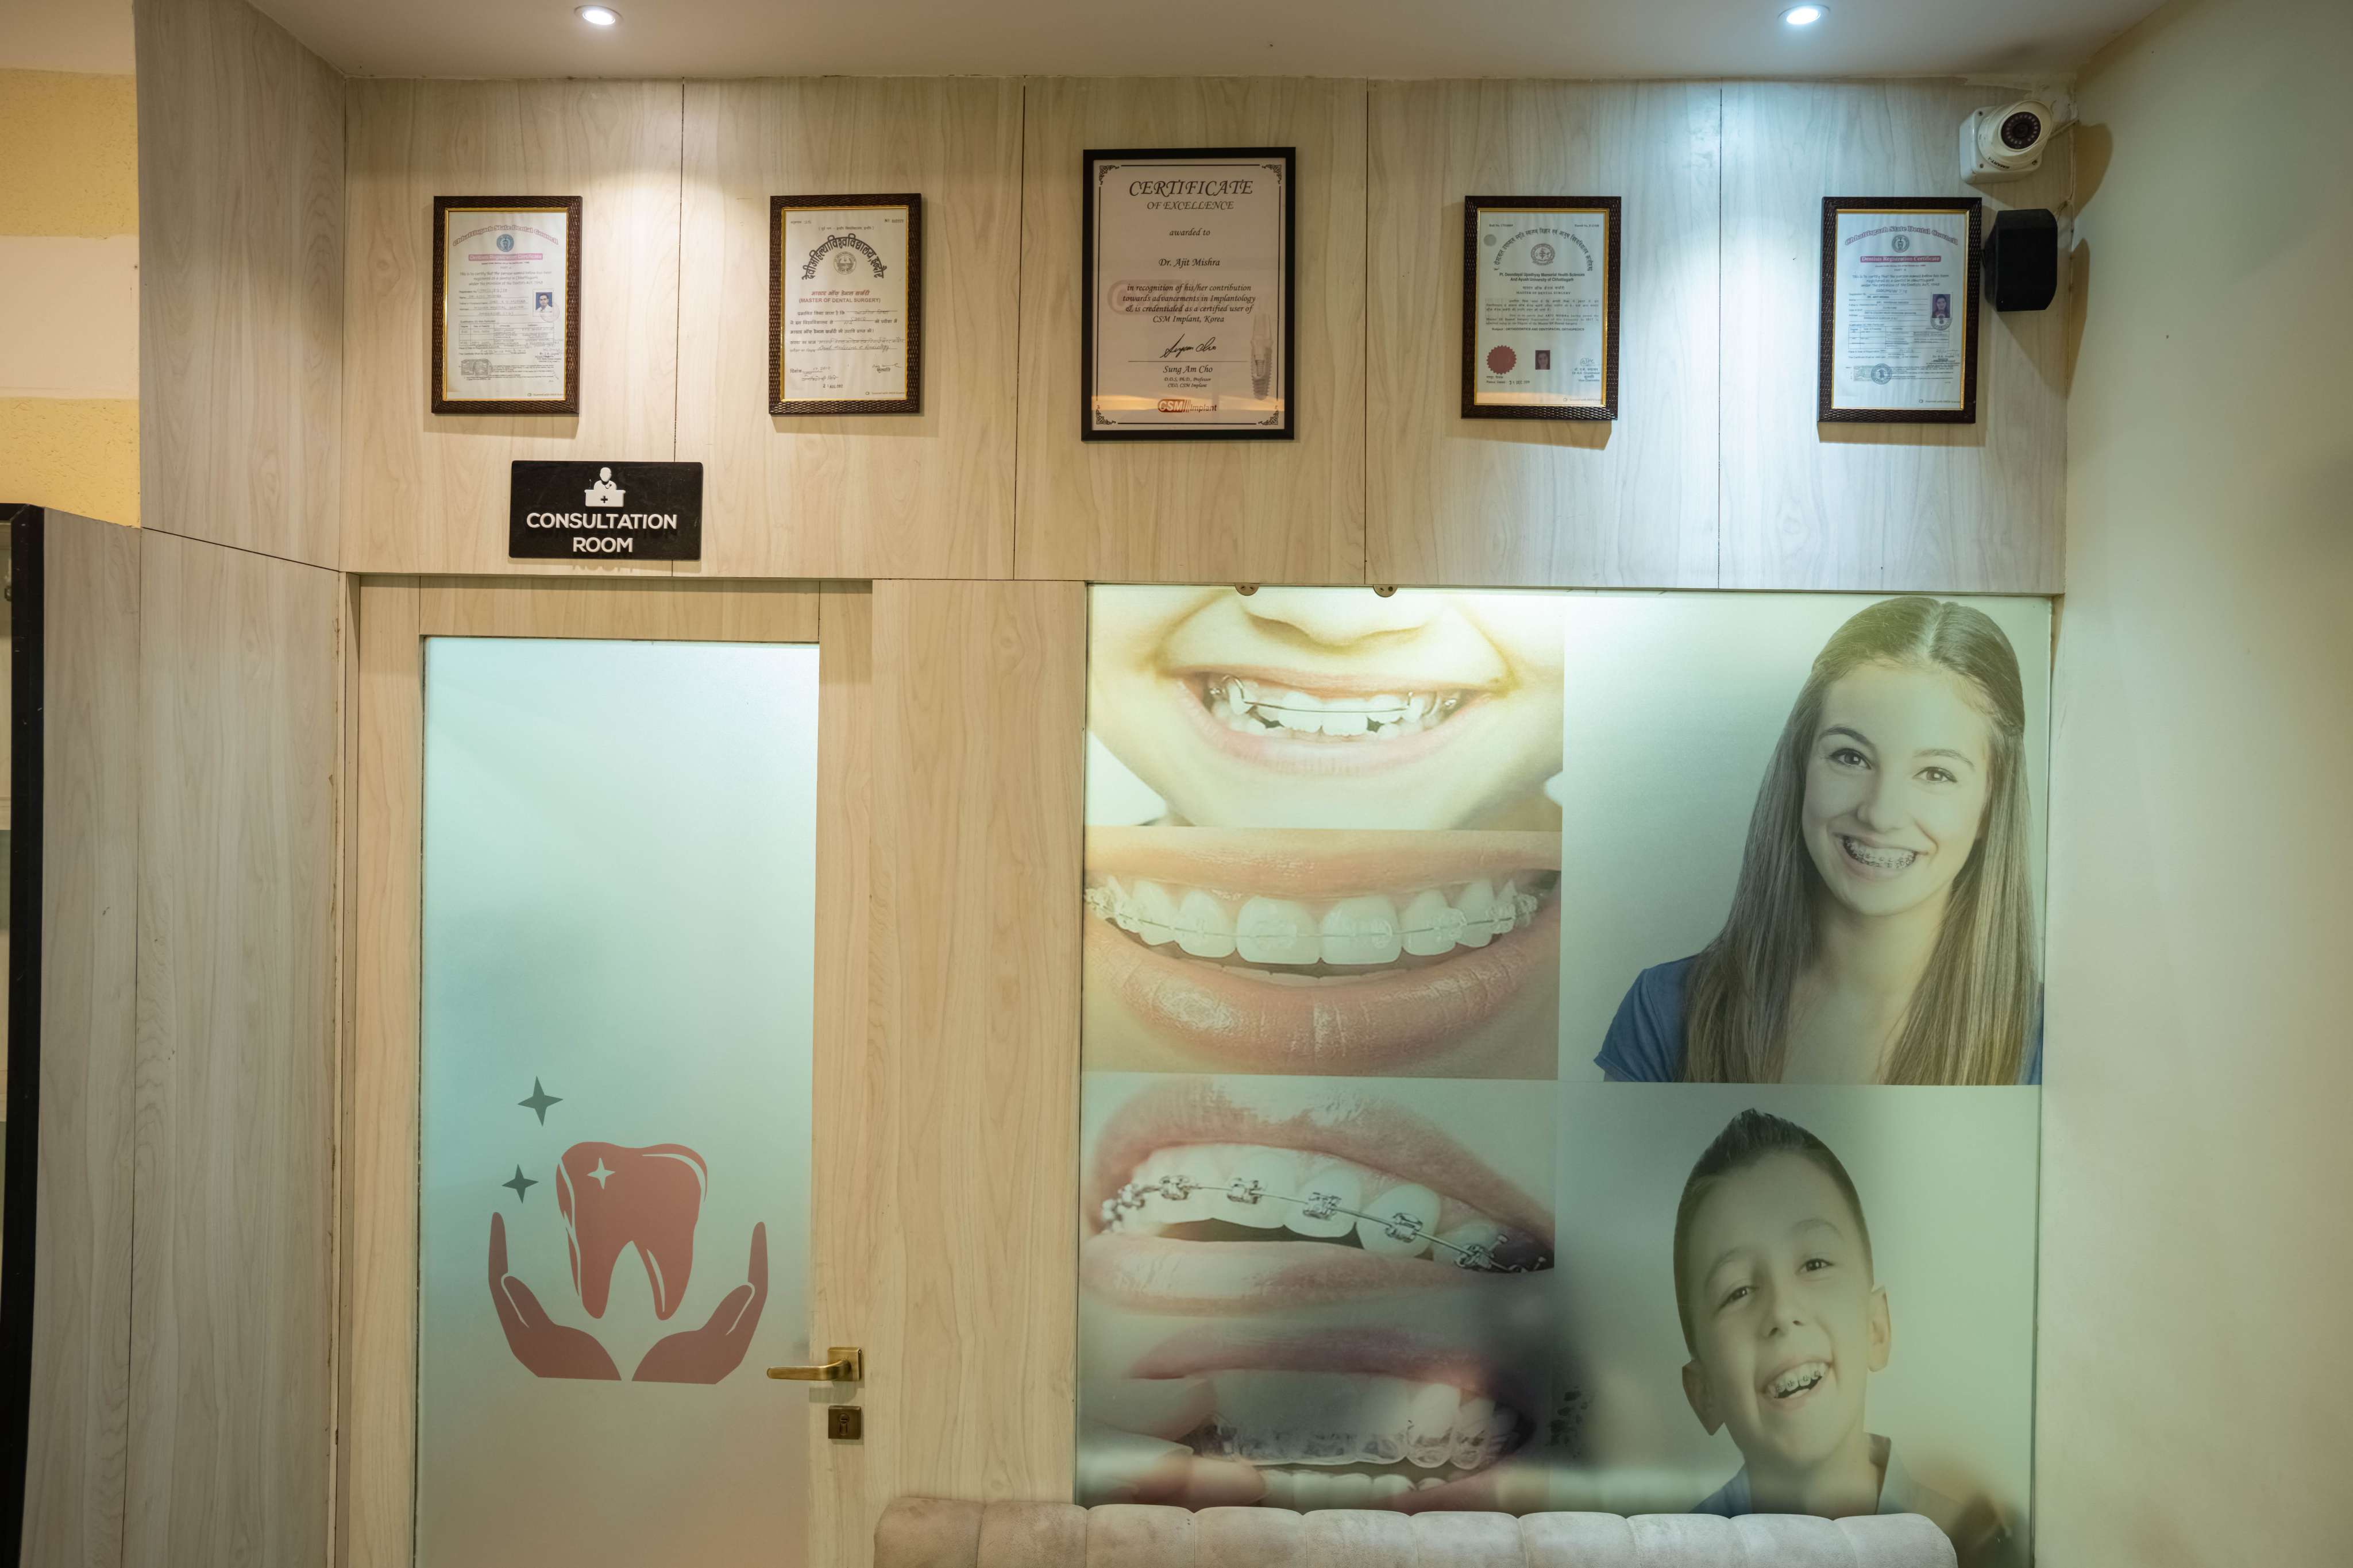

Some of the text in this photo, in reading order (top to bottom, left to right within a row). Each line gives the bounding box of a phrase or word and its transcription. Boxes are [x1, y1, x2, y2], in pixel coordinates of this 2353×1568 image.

[1129, 179, 1253, 197] CERTIFICATE
[1147, 202, 1234, 210] OF EXCELLENCE
[1173, 258, 1190, 268] Ajit
[1136, 284, 1173, 293] recognition
[1176, 284, 1182, 293] of
[1184, 284, 1208, 293] his/her
[1210, 295, 1255, 303] Implantology
[1200, 304, 1227, 314] certified
[1245, 305, 1253, 314] of
[1172, 316, 1201, 324] Implant,
[1163, 366, 1181, 374] Sung
[1159, 400, 1217, 412] CSM Implant
[526, 512, 677, 530] CONSULTATION
[573, 537, 633, 553] ROOM
